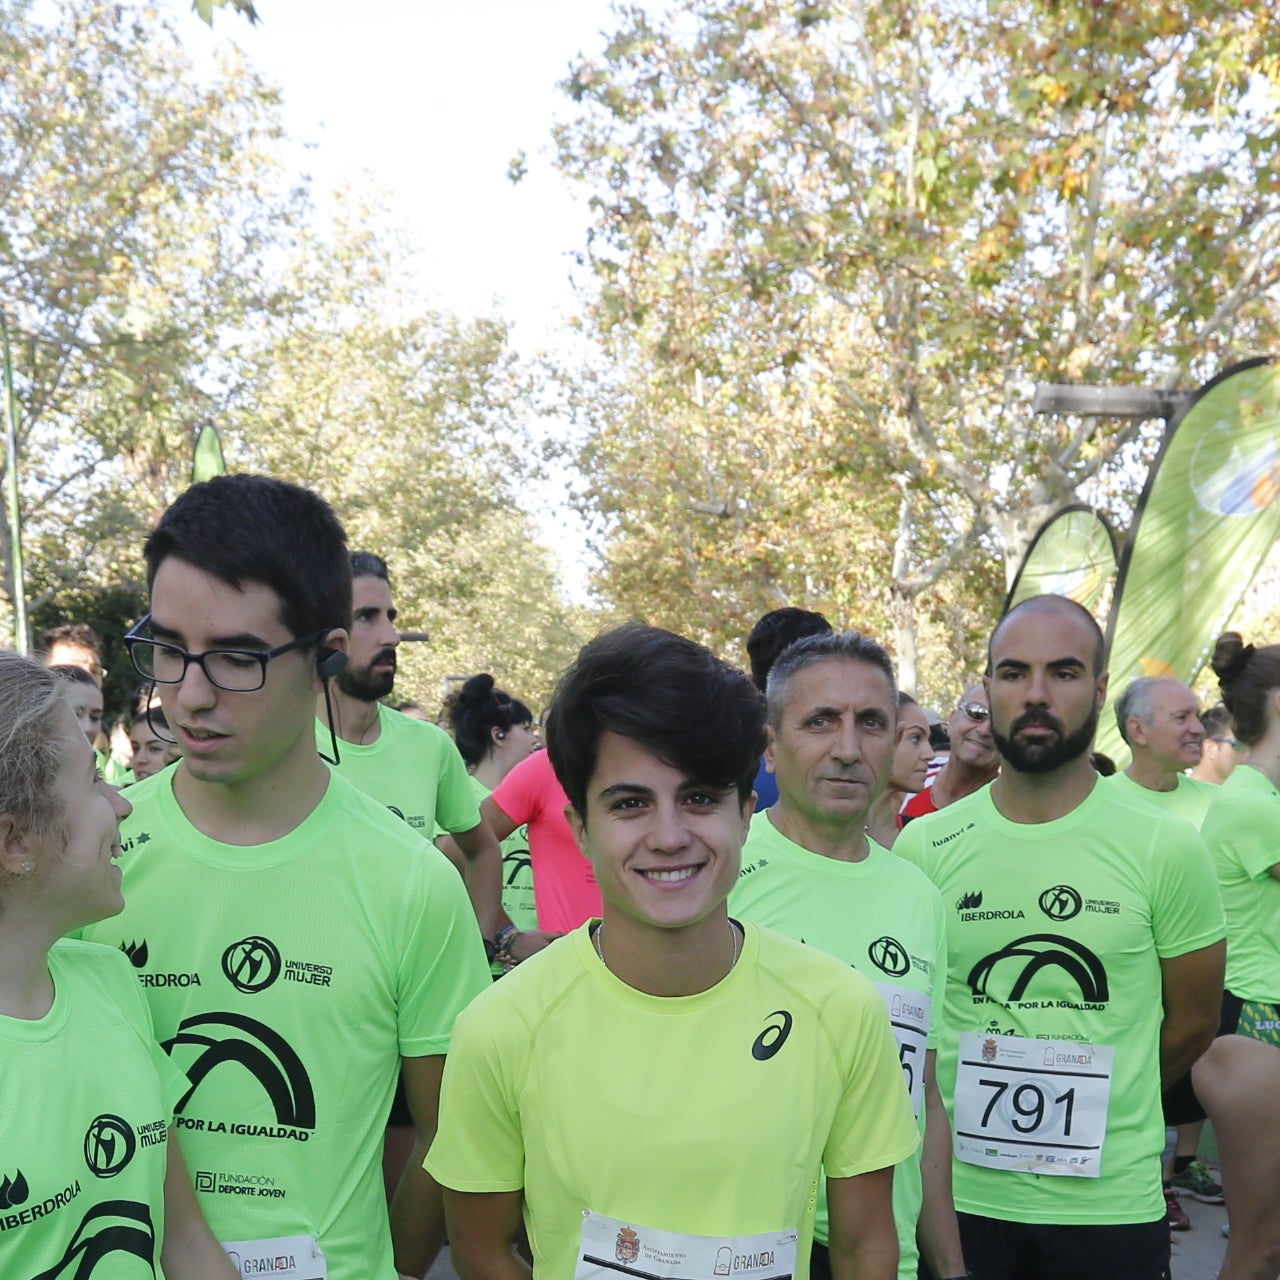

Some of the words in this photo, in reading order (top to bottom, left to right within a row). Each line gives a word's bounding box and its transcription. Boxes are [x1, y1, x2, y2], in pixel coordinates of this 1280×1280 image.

[932, 827, 965, 848] luanvi
[960, 910, 1025, 922] IBERDROLA
[1084, 905, 1120, 915] MUJER
[285, 960, 333, 976] UNIVERSO
[284, 971, 331, 988] MUJER
[1018, 1002, 1040, 1010] POR
[1041, 1001, 1054, 1009] LA
[1056, 1000, 1106, 1011] IGUALDAD
[1056, 1053, 1093, 1066] GRANADA
[978, 1079, 1076, 1137] 791
[176, 1117, 204, 1131] POR
[207, 1118, 227, 1133] LA
[230, 1123, 310, 1142] IGUALDAD
[218, 1173, 276, 1186] FUNDACIÓN
[218, 1185, 256, 1196] DEPORTE
[257, 1186, 286, 1198] JOVEN
[244, 1255, 296, 1274] GRANADA
[733, 1250, 775, 1270] GRANADA
